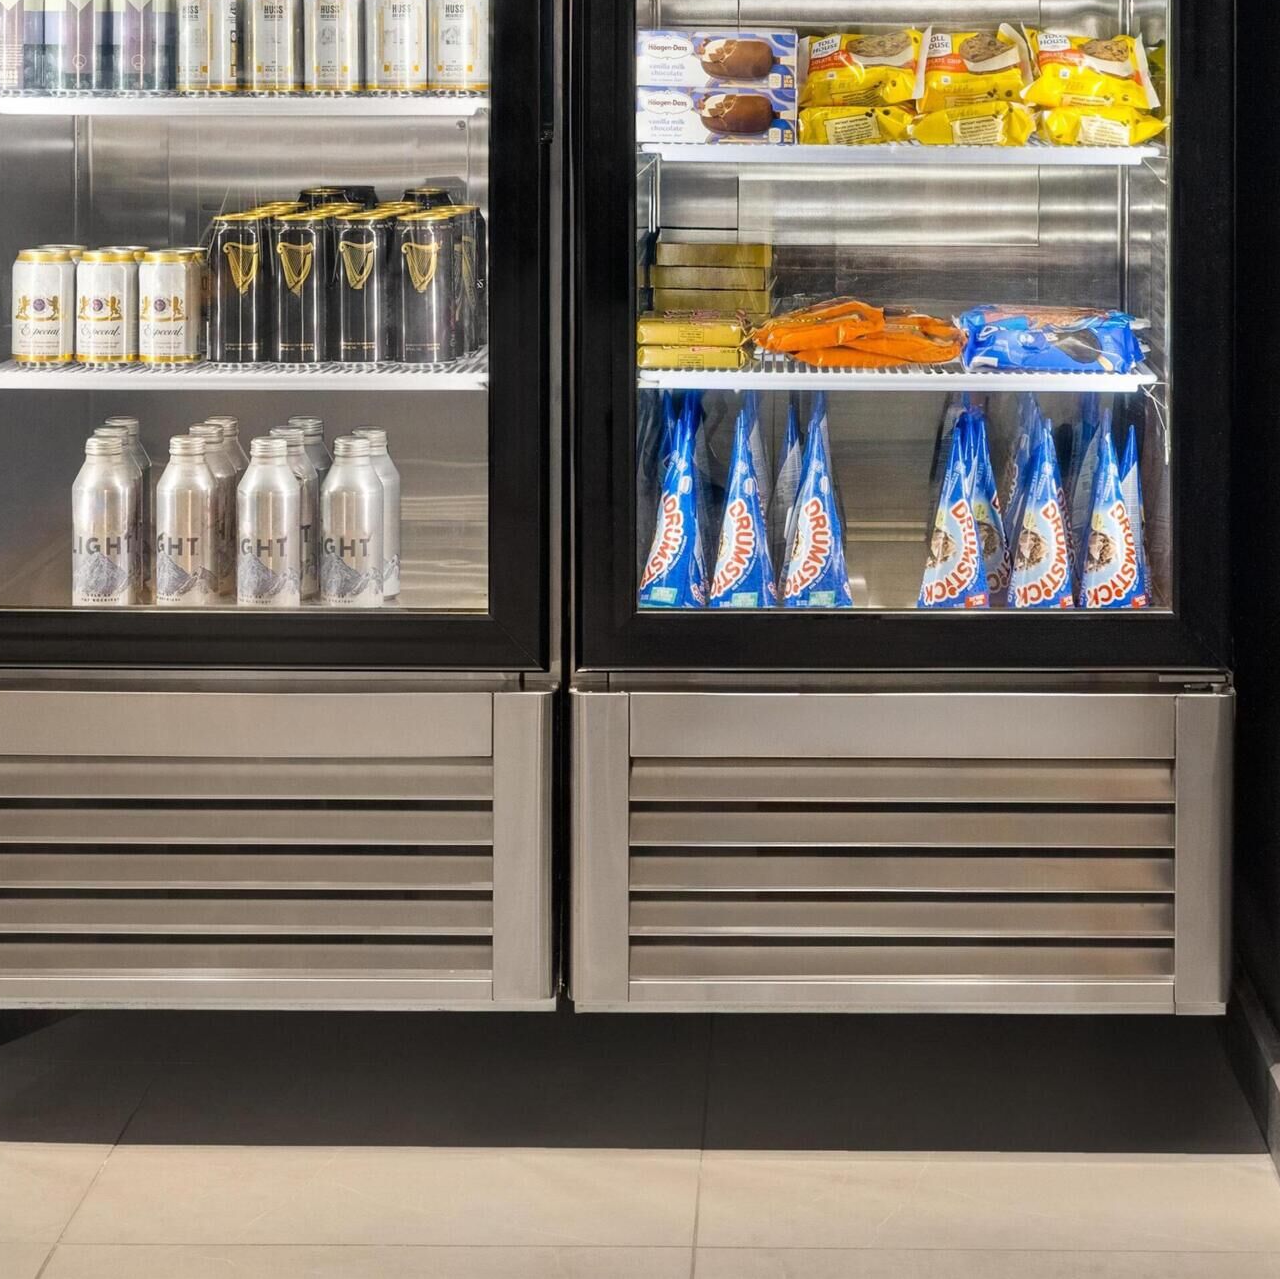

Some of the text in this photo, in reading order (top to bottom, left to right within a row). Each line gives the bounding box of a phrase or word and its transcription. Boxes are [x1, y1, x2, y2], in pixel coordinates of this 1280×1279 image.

[264, 5, 283, 14] HUSS
[445, 4, 464, 13] HUSS
[817, 38, 835, 48] TOLL
[929, 41, 951, 50] OUSE
[1039, 38, 1068, 46] HOUSE
[648, 43, 687, 52] Häagen-Dazs
[812, 42, 838, 54] HOUSE
[648, 99, 687, 107] Häagen-Dazs
[158, 533, 200, 556] GHT
[926, 501, 977, 604] DRUMSTICK
[1017, 502, 1067, 606] DRUMSTICK
[1088, 503, 1137, 606] DRUMSTICK
